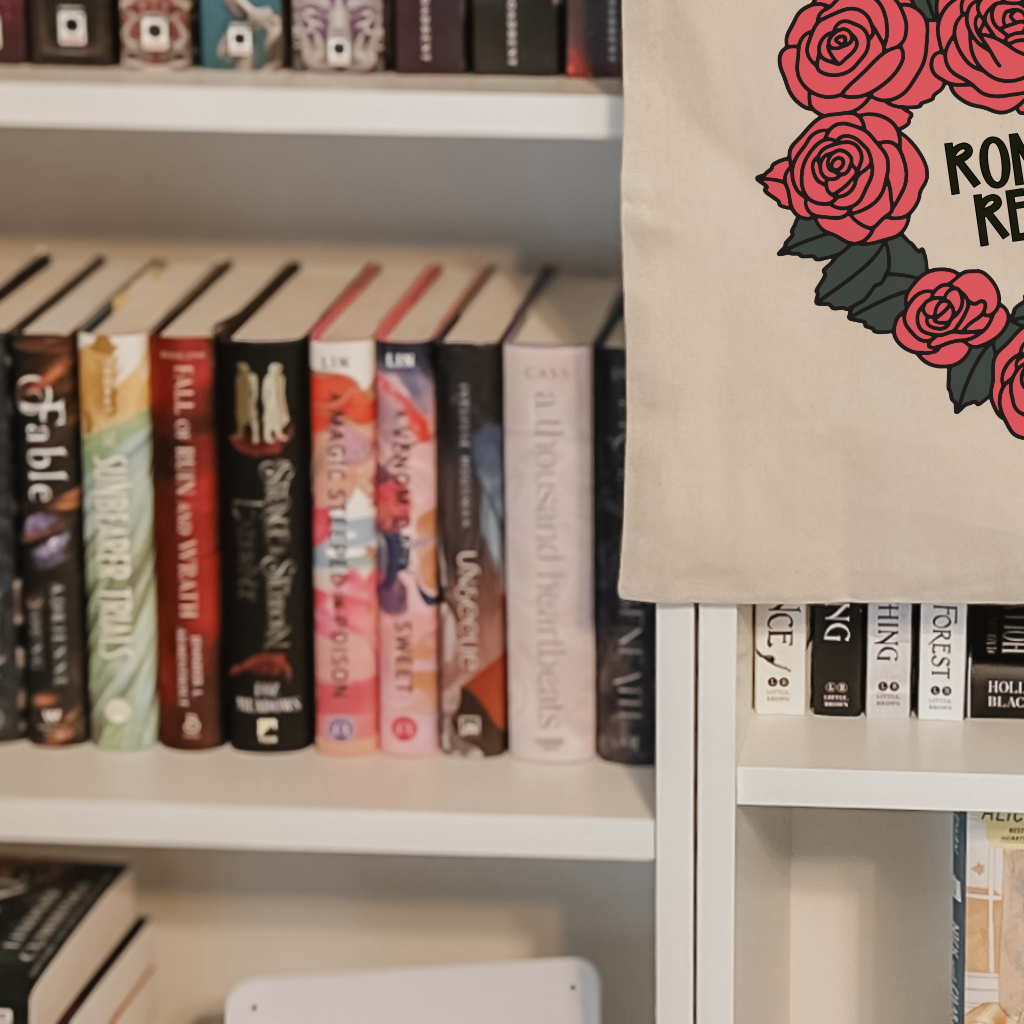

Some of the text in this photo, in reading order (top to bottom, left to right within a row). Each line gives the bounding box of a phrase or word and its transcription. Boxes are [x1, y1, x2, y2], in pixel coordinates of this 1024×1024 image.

[173, 364, 196, 417] FALL
[385, 351, 416, 369] LIN
[16, 373, 69, 504] Fable
[174, 445, 197, 497] RUIN
[328, 410, 345, 481] MAGIC
[534, 419, 565, 562] thousand
[395, 620, 413, 694] SWEET
[928, 605, 958, 679] FOREST
